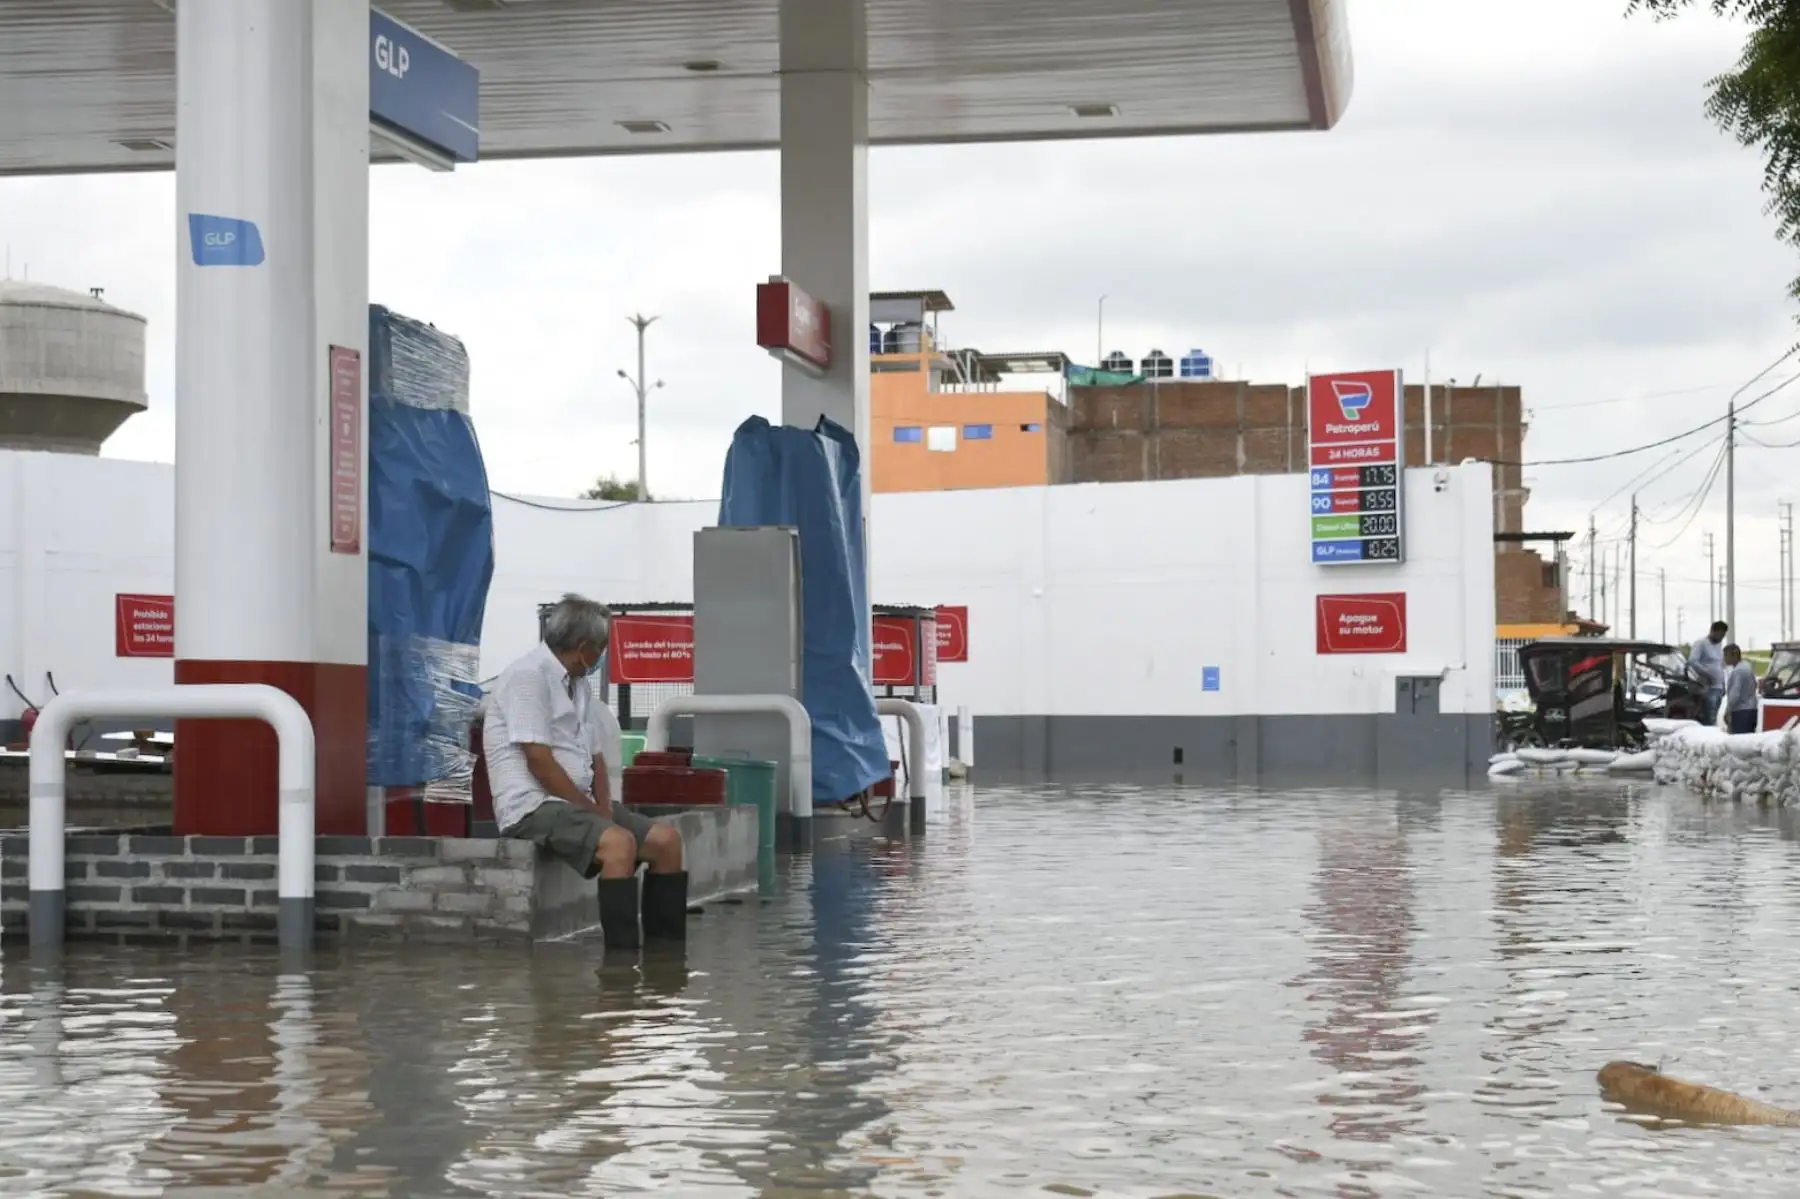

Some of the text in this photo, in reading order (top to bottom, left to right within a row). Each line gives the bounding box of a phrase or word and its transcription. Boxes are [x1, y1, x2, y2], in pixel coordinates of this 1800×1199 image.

[375, 34, 410, 79] GLP
[204, 232, 236, 246] GLP
[1325, 421, 1380, 435] Petroperú
[1328, 446, 1381, 460] 24 HORAS
[1311, 473, 1329, 486] 84
[1366, 467, 1395, 484] 17.75
[1311, 497, 1331, 509] 90
[1366, 491, 1395, 509] 19.55
[1362, 516, 1395, 534] 20.00
[1316, 545, 1335, 556] GLP
[1369, 540, 1397, 558] 10.25
[133, 608, 168, 619] Prohibido
[1338, 613, 1378, 625] Apague
[133, 622, 172, 631] estacionar
[1338, 625, 1384, 635] su motor
[654, 641, 666, 649] del
[640, 651, 662, 659] hasta
[663, 651, 670, 659] el
[671, 651, 692, 659] 80%
